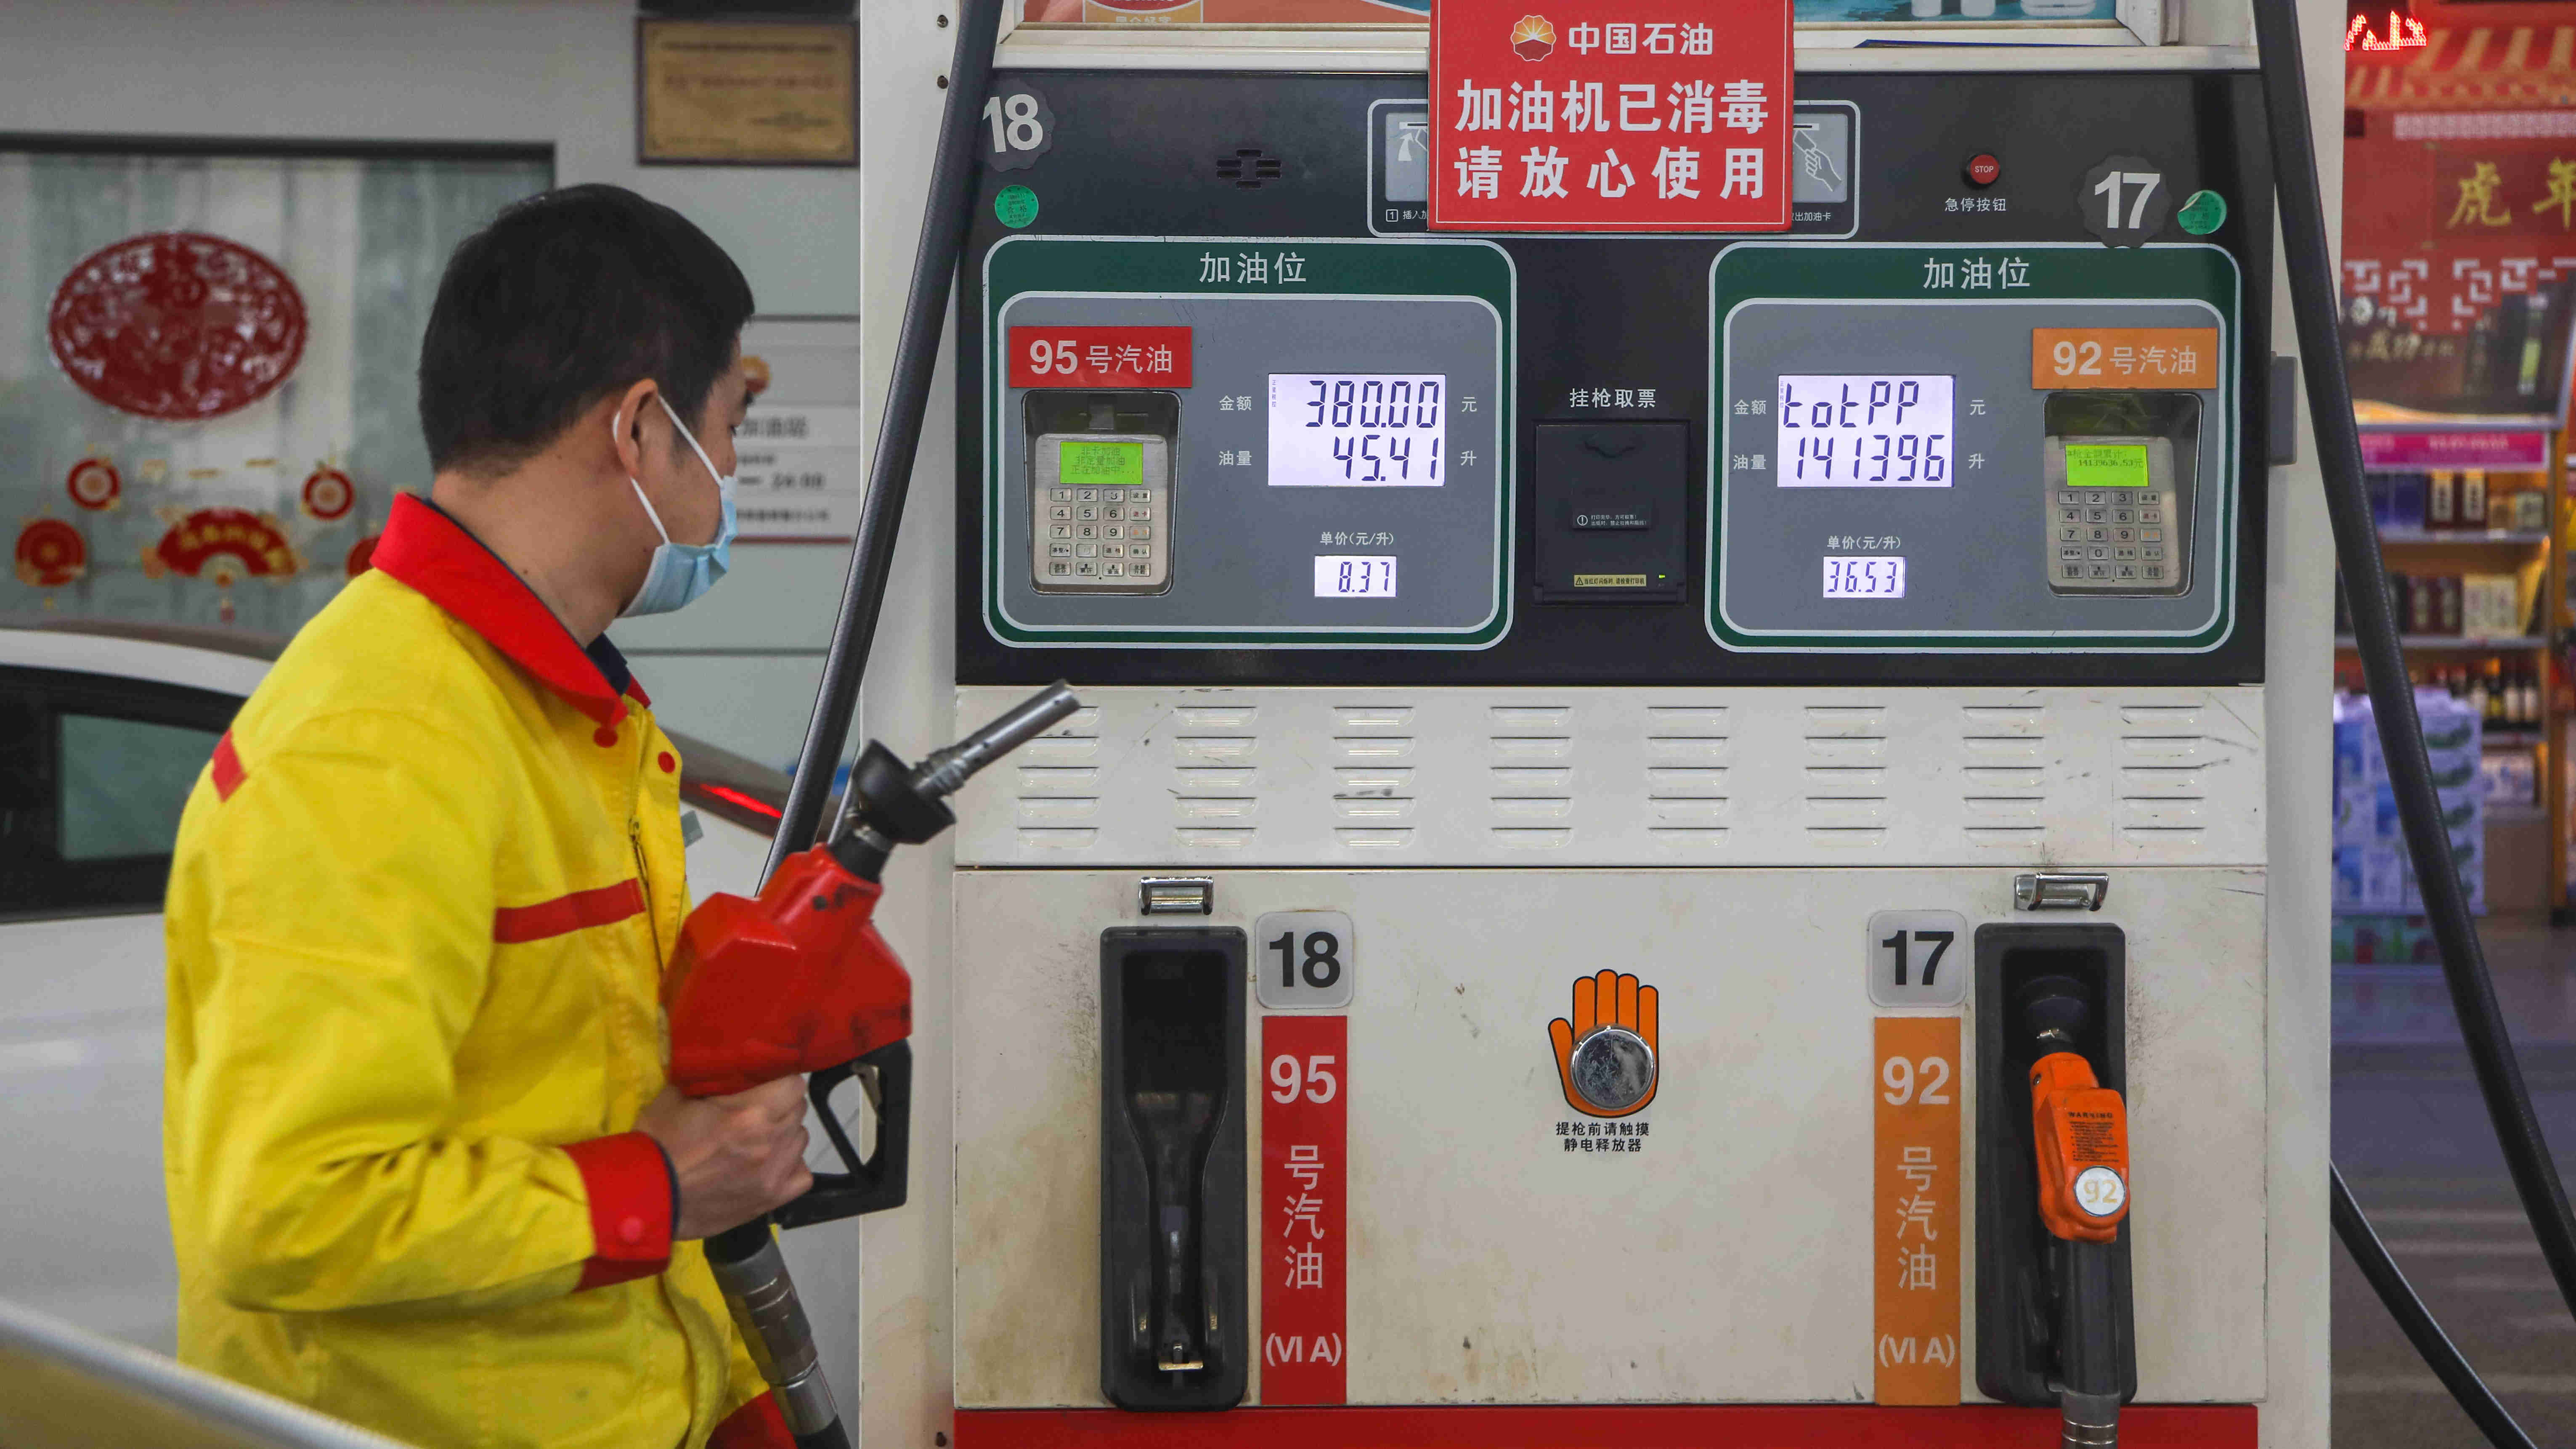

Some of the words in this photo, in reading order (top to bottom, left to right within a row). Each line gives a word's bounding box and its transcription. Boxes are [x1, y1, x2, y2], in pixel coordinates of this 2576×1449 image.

[1568, 21, 1714, 56] 中国石油
[1455, 79, 1770, 135] 加油机已消毒
[983, 94, 1043, 153] 18
[1454, 146, 1765, 200] 请放心使用
[1944, 197, 2007, 212] 急停按钮
[2094, 171, 2160, 229] 17
[1792, 212, 1831, 221] 出加油卡
[1199, 252, 1306, 284] 加油位
[1923, 257, 2031, 289] 加油位
[1029, 339, 1173, 375] 95号汽油
[2053, 341, 2197, 376] 92号汽油
[1219, 395, 1252, 411] 金额
[1305, 380, 1439, 428] 380.00
[1461, 397, 1477, 413] 元
[1569, 388, 1656, 408] 挂枪取票
[1733, 399, 1767, 416] 金额
[1970, 400, 1986, 416] 元
[1218, 450, 1252, 466] 油量
[1333, 434, 1439, 481] 45.41
[1460, 450, 1477, 466] 升
[1732, 454, 1767, 470] 油量
[1796, 434, 1945, 481] 141396
[1968, 453, 1985, 469] 升
[1084, 491, 1091, 499] 2
[1057, 527, 1064, 535] 7
[1319, 531, 1394, 546] 单价(元/升)
[1826, 535, 1901, 550] 单价(元/升)
[2067, 530, 2075, 538] 7
[2095, 549, 2102, 557] 0
[1338, 561, 1390, 593] 8.37
[1827, 561, 1897, 593] 36.53
[1269, 931, 1341, 988] 18
[1882, 930, 1954, 985] 17
[1270, 1054, 1337, 1104] 95
[1883, 1056, 1950, 1105] 92
[1556, 1122, 1650, 1136] 提枪前请触摸
[1564, 1138, 1642, 1152] 静电释放器
[2084, 1179, 2117, 1204] 92
[1283, 1144, 1325, 1289] 号汽油
[1896, 1146, 1938, 1291] 号汽油
